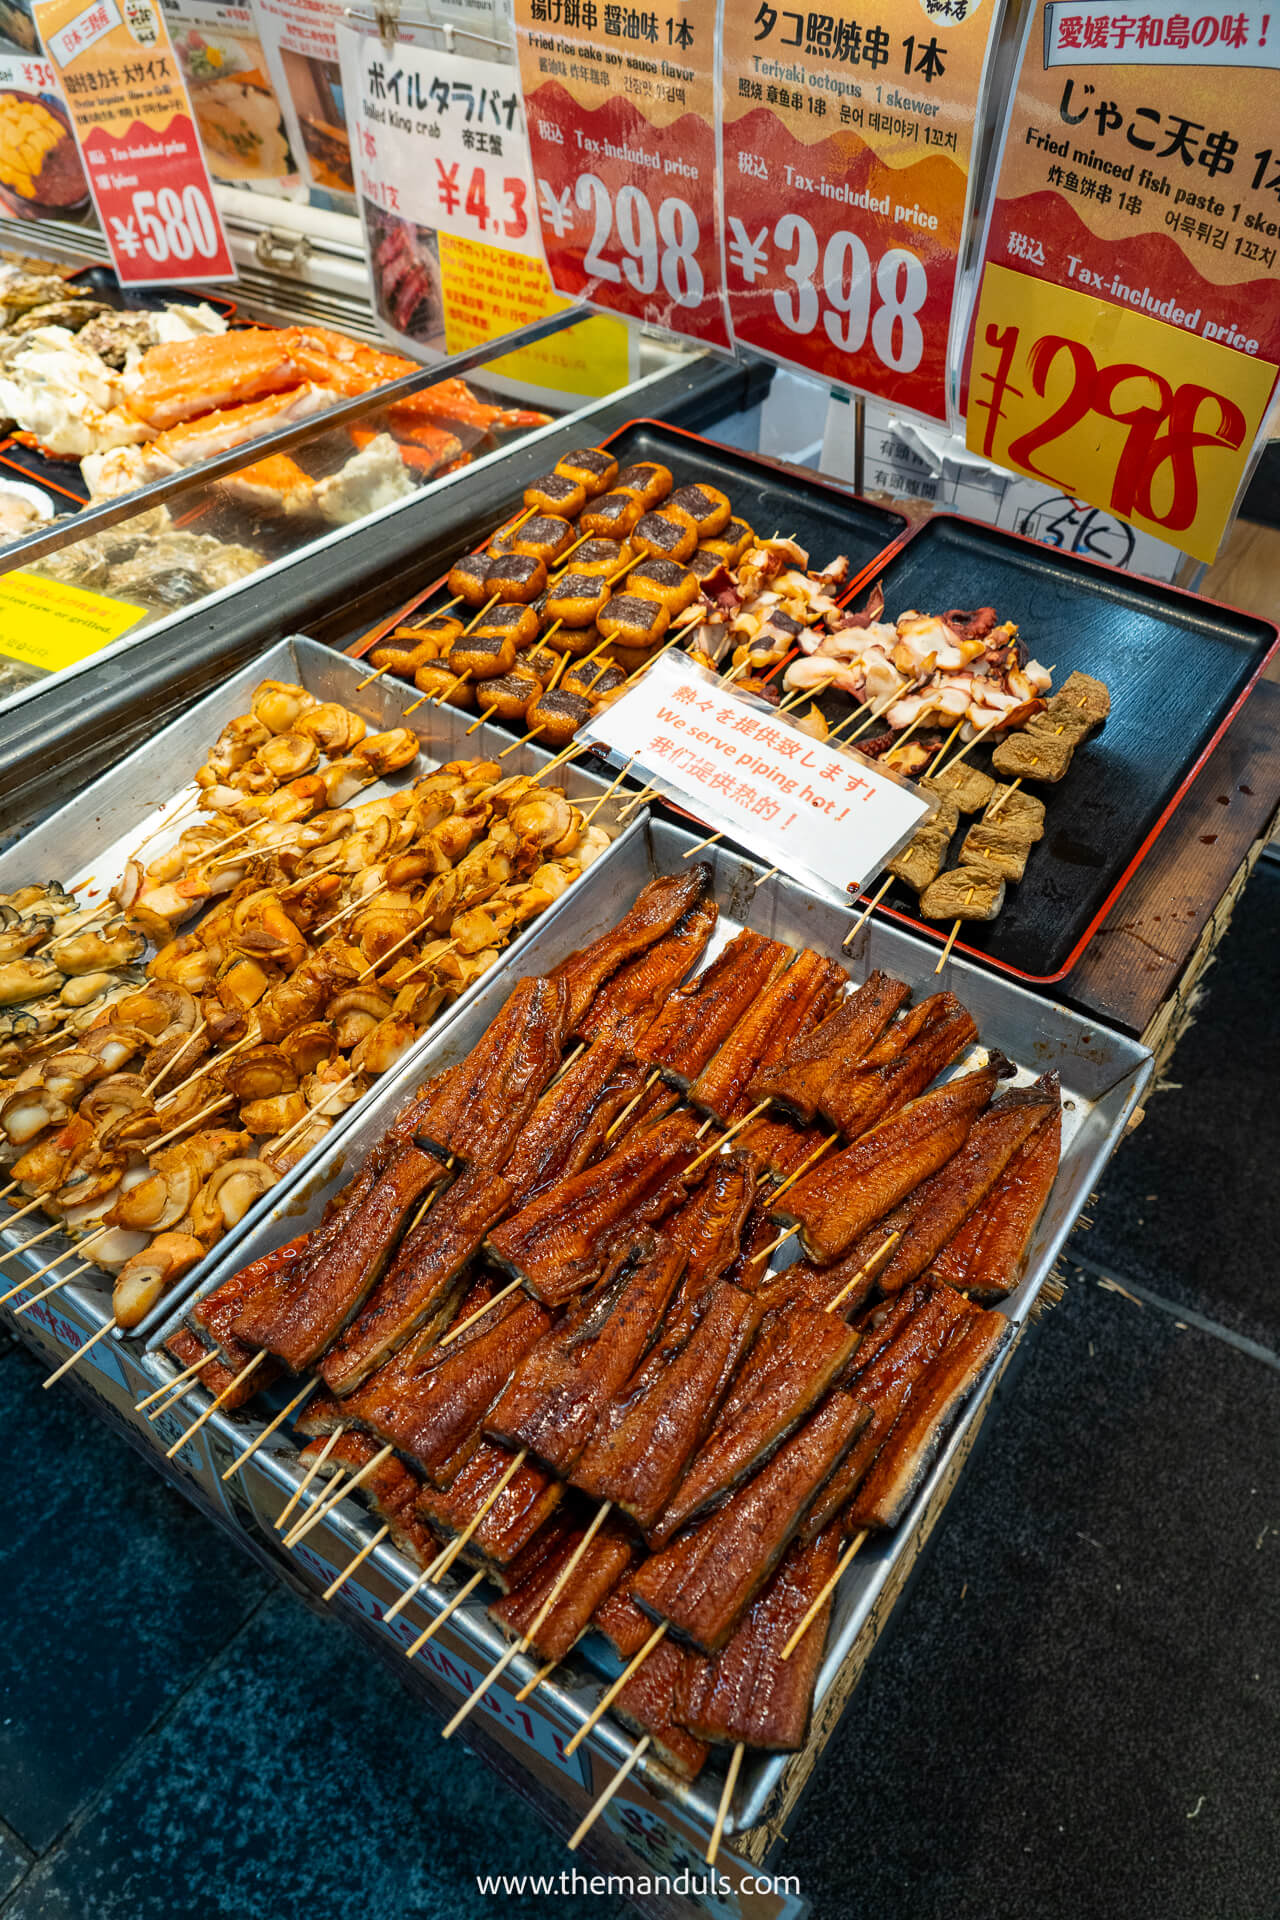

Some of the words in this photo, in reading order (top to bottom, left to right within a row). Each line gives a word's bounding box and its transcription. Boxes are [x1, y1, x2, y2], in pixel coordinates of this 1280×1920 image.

[531, 0, 598, 31] 揚げ餅串
[604, 3, 659, 44] 醤油味
[665, 17, 695, 50] 1本
[753, 2, 890, 70] タコ照焼串
[902, 35, 948, 83] 1本
[1057, 13, 1271, 50] 愛媛宇和島の味！
[529, 32, 554, 52] Fried
[557, 39, 576, 56] rice
[578, 45, 602, 61] cake
[605, 52, 622, 69] soy
[626, 57, 657, 74] sauce
[661, 60, 695, 82] flavor
[752, 55, 805, 84] Teriyaki
[808, 74, 861, 98] octopus
[875, 86, 882, 103] 1
[886, 90, 940, 117] skewer
[738, 77, 763, 101] 照烧
[766, 85, 803, 111] 章鱼串
[808, 97, 827, 117] 1串
[1059, 78, 1239, 178] じゃこ天串
[416, 120, 441, 139] crab
[462, 128, 503, 156] 帝王蟹
[574, 129, 660, 169] Tax-included
[664, 157, 699, 180] price
[839, 104, 864, 128] 문어
[868, 112, 919, 143] 데리야키
[924, 127, 958, 153] 1꼬치
[737, 151, 769, 181] 税込
[1026, 127, 1069, 158] Fried
[1073, 150, 1135, 182] minced
[1139, 169, 1171, 196] fish
[1175, 188, 1225, 216] paste
[1231, 204, 1241, 222] 1
[1047, 165, 1112, 204] 炸鱼饼串
[1118, 193, 1143, 215] 1串
[110, 185, 217, 262] ¥580
[783, 165, 890, 216] Tax-included
[894, 204, 938, 230] price
[537, 173, 704, 308] ¥298
[1007, 231, 1046, 266] 税込
[1165, 210, 1229, 250] 어묵튀김
[1235, 237, 1276, 269] 1꼬치
[728, 213, 928, 374] ¥398
[1067, 255, 1200, 330] Tax-included
[1201, 318, 1259, 355] price
[976, 324, 1246, 531] ¥298
[656, 706, 687, 730] We
[686, 722, 738, 757] serve
[735, 751, 800, 795] piping
[671, 683, 877, 802] 熱々を提供致します!
[649, 735, 799, 831] 我们提供热的！
